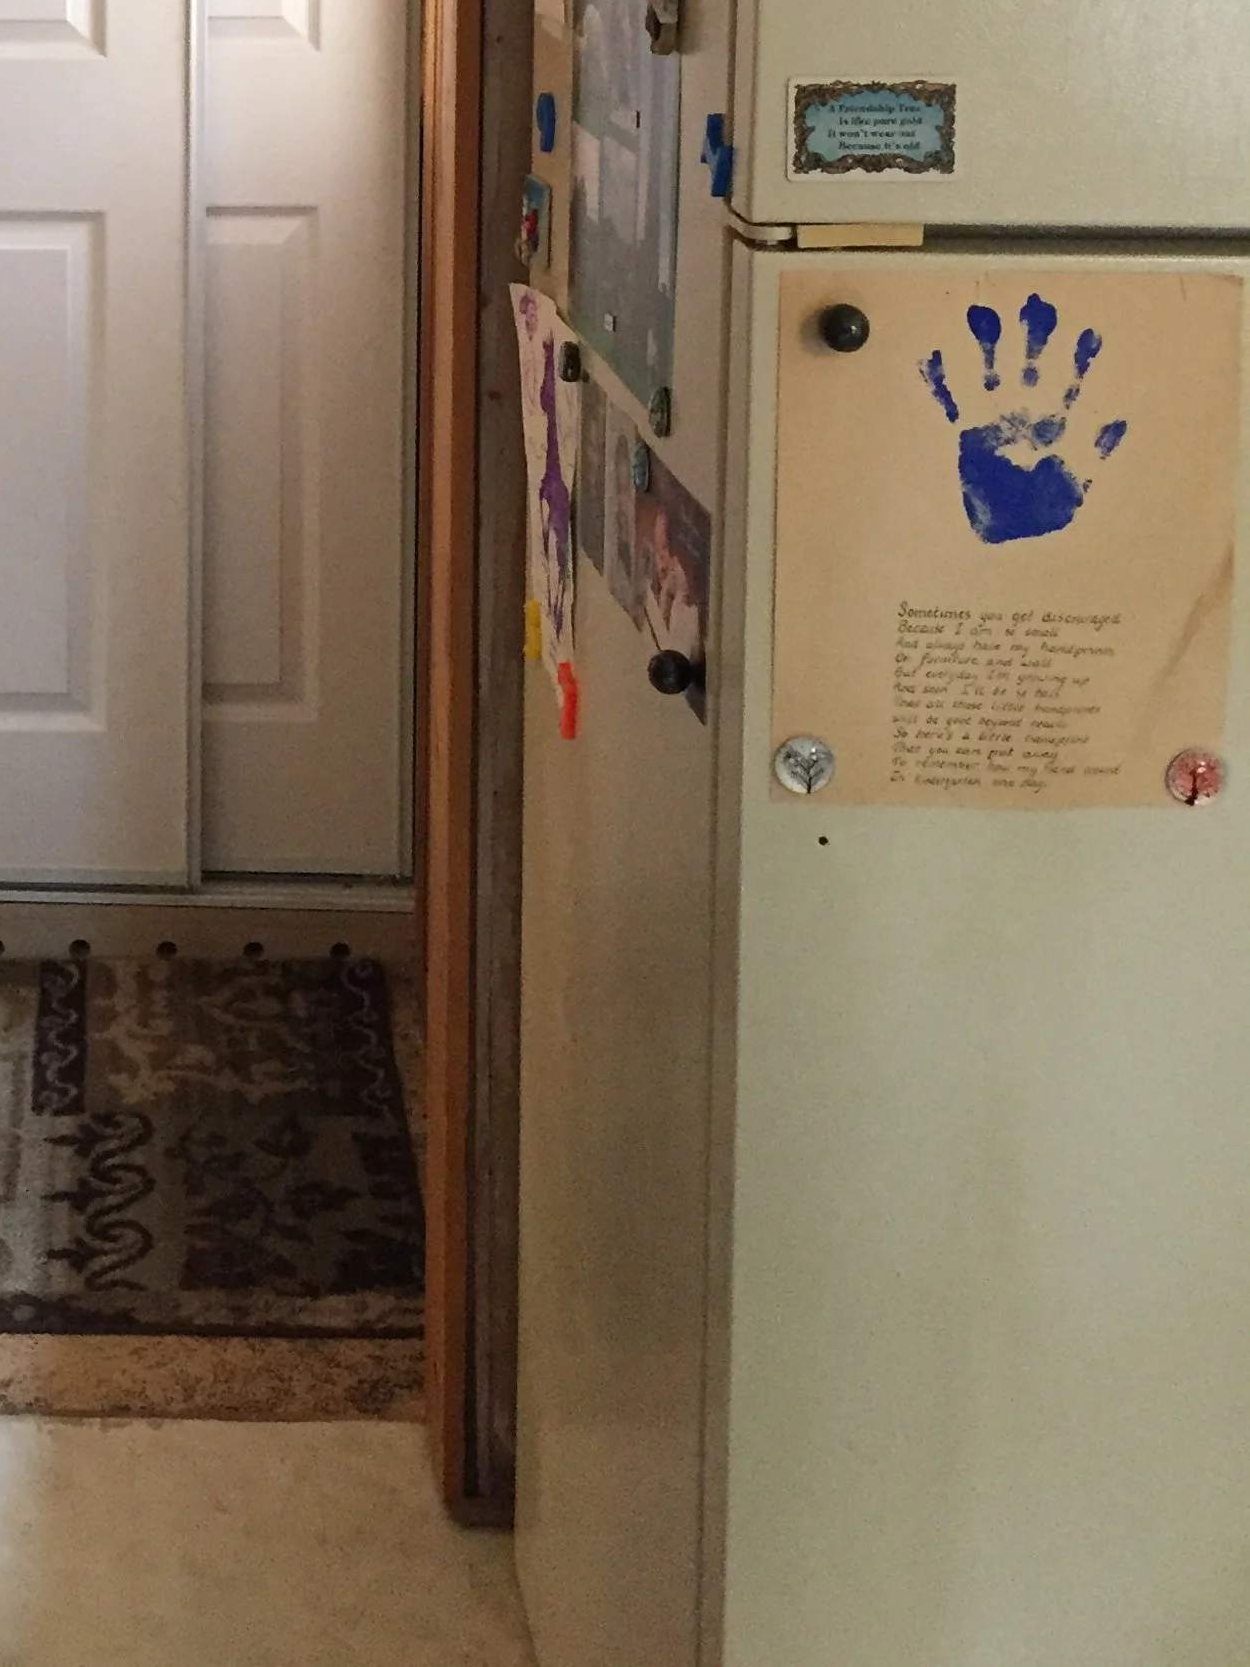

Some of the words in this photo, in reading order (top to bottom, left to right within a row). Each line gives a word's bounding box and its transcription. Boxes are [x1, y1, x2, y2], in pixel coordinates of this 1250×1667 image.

[839, 103, 895, 114] Friendship
[900, 117, 923, 126] gold
[839, 129, 868, 137] won't
[838, 141, 881, 150] Because
[903, 141, 920, 150] old
[898, 600, 971, 619] Sometimes
[980, 612, 1002, 623] you
[1012, 610, 1033, 627] get
[1042, 612, 1121, 632] discouraged
[897, 620, 945, 634] Because
[954, 622, 964, 635] I
[969, 627, 992, 636] am
[1025, 627, 1059, 637] small
[914, 652, 979, 672] furniture
[986, 658, 1013, 667] and
[922, 685, 948, 694] soon
[992, 685, 1007, 696] be
[926, 715, 938, 725] be
[893, 727, 908, 738] So
[915, 729, 953, 741] here's
[928, 746, 949, 758] you
[987, 747, 1014, 760] put
